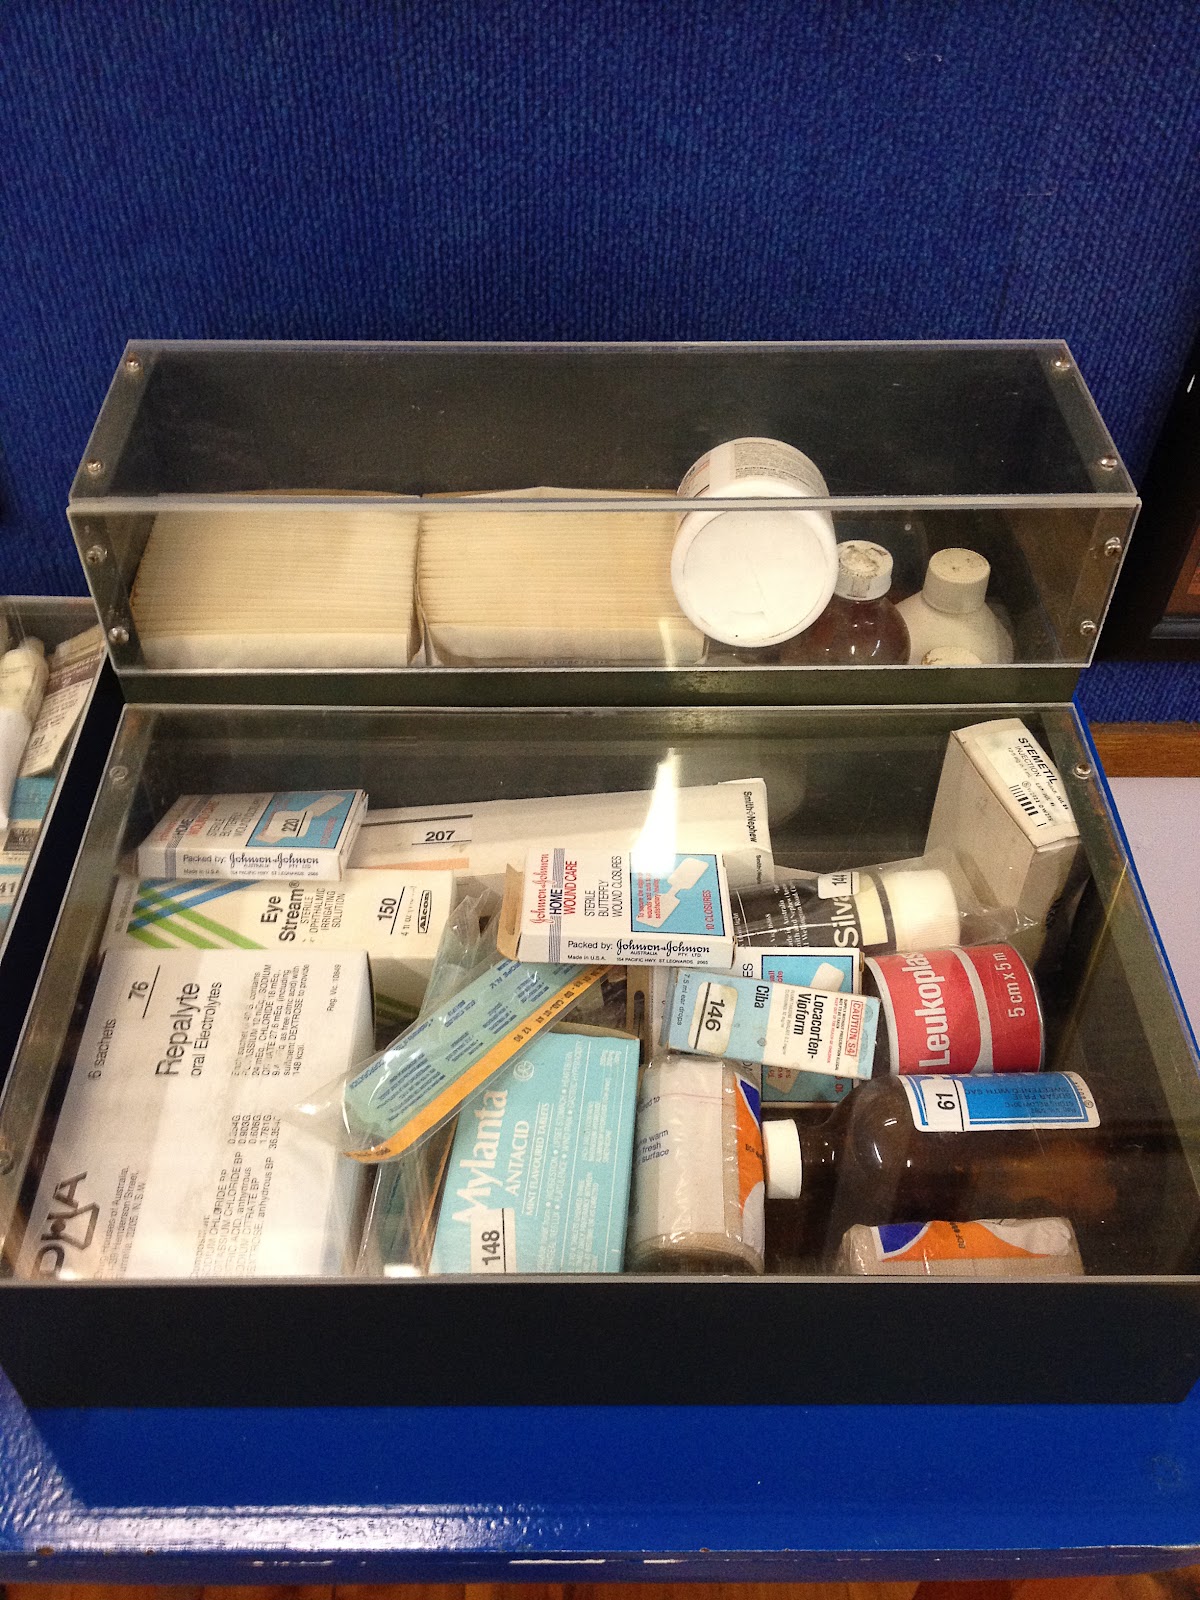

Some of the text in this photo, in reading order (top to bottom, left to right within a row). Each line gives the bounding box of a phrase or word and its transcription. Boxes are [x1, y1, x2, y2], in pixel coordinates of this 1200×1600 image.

[1015, 746, 1041, 777] INJECTION
[1018, 737, 1058, 784] STEMETIL
[282, 818, 299, 832] 220
[425, 830, 456, 842] 207
[745, 816, 757, 842] Nephew
[183, 854, 212, 864] Packed
[230, 852, 319, 868] Johnson Johnson
[529, 852, 557, 924] Johnson Johnson
[564, 860, 578, 914] WOUND CARE
[611, 855, 622, 918] WOUND CLOSURES
[832, 874, 848, 887] 144
[261, 894, 282, 924] Eye
[301, 896, 314, 924] STERILE
[309, 888, 325, 934] OPHTHALMIC
[321, 890, 335, 931] IRRIGATING
[332, 893, 346, 928] SOLUTION
[377, 898, 397, 921] 150
[420, 892, 430, 929] Alcon
[550, 889, 562, 915] HOME
[584, 890, 595, 917] STERILE
[598, 880, 610, 917] BUTTERFLY
[703, 889, 713, 931] 10 CLOSURES
[568, 940, 613, 952] Packed by:
[616, 939, 710, 958] Johnson Johnson
[128, 980, 150, 1001] 76
[248, 971, 261, 1000] contains
[252, 963, 271, 1026] 12 SODIUM
[682, 973, 690, 983] 7.5
[992, 952, 1025, 1018] 5 cm x 5 m
[280, 1032, 287, 1040] as
[290, 964, 300, 978] with
[288, 997, 303, 1041] DEXTROSE
[297, 963, 310, 988] provide
[326, 981, 338, 1012] Reg. Vic.
[754, 985, 770, 1008] Ciba
[155, 982, 200, 1077] Repalyte
[190, 981, 222, 1077] oral Electrolytes
[258, 1000, 273, 1041] CHLORIDE
[521, 1025, 532, 1035] 12
[676, 1006, 685, 1026] drops
[706, 999, 724, 1032] 146
[793, 993, 812, 1036] Vioform
[807, 995, 828, 1060] Locacorten-
[846, 1002, 860, 1053] CAUTION S4
[88, 1018, 116, 1080] 6 sachets
[938, 1092, 956, 1111] 61
[552, 1128, 562, 1149] UPSET
[641, 1140, 661, 1153] fresh
[648, 1129, 669, 1142] warm
[452, 1090, 507, 1222] Mylanta
[504, 1122, 530, 1197] ANTACID
[524, 1102, 550, 1215] MINT FLAVOURED TABLETS
[640, 1147, 670, 1163] surface
[223, 1165, 241, 1217] CHLORIDE
[233, 1150, 243, 1164] BP
[250, 1176, 260, 1190] BP
[257, 1156, 275, 1217] anhydrous BP
[209, 1183, 226, 1235] CHLORIDE
[230, 1165, 252, 1241] ACID, anhydrous
[482, 1230, 500, 1266] 148
